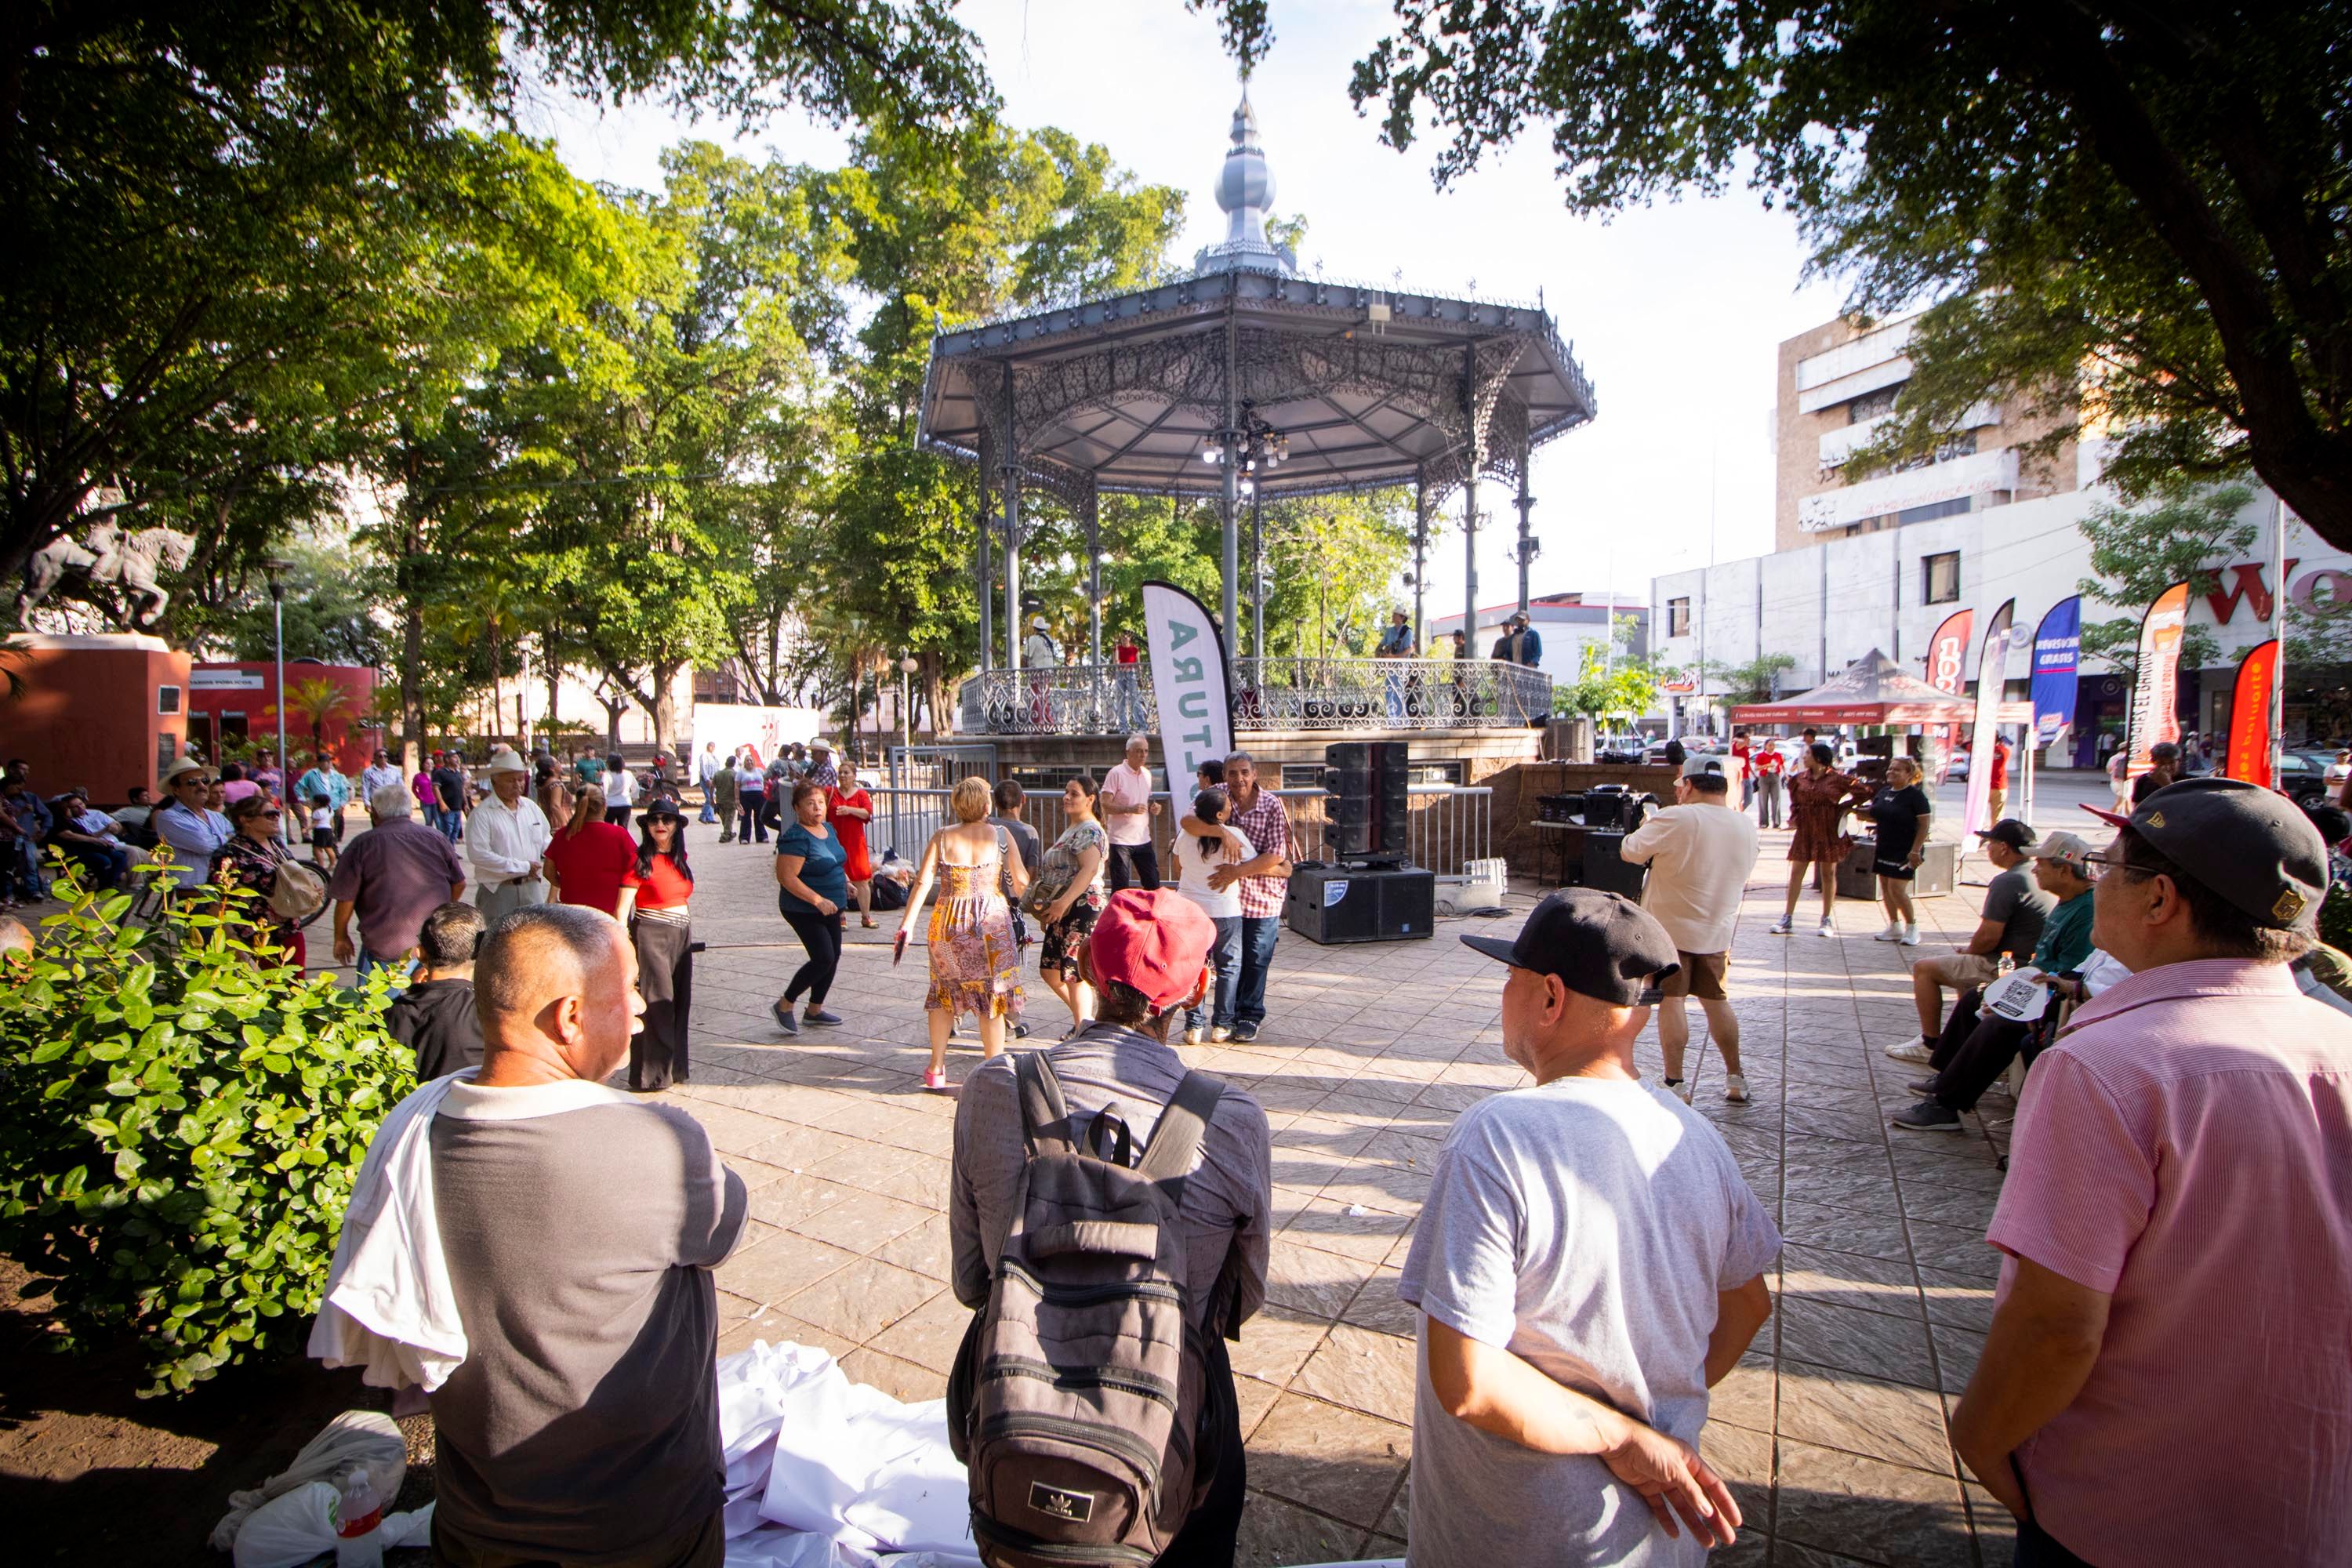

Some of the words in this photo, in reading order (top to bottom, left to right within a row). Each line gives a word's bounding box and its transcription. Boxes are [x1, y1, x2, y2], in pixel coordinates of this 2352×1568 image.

[2039, 652, 2074, 665] GRATIS
[2136, 652, 2153, 692] BARRIO
[2134, 695, 2151, 706] EL
